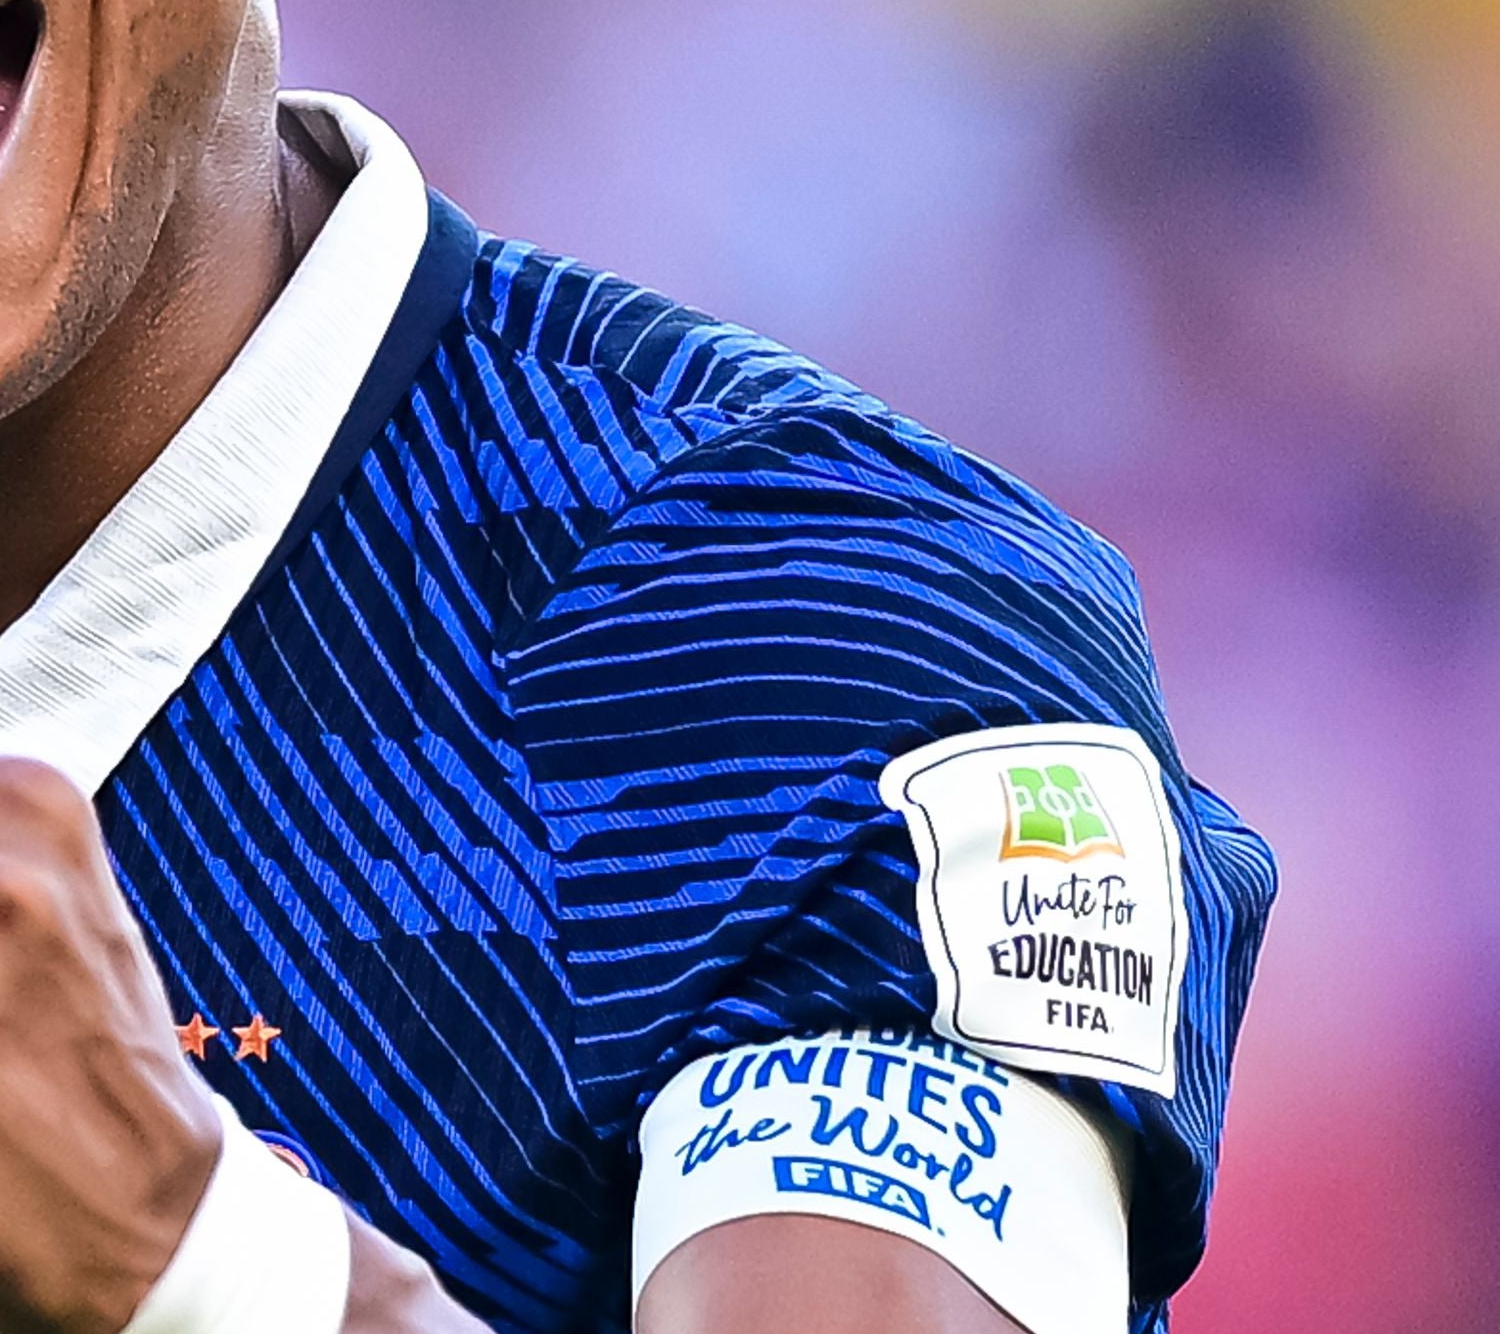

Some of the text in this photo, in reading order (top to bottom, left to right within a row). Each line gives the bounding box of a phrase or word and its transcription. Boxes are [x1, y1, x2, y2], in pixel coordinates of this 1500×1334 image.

[1003, 872, 1137, 931] Unite For
[987, 931, 1153, 1007] EDUCATION
[1046, 998, 1109, 1034] FIFA
[699, 1046, 1002, 1159] UNITES
[675, 1094, 1013, 1242] the World
[788, 1160, 926, 1223] FIFA
